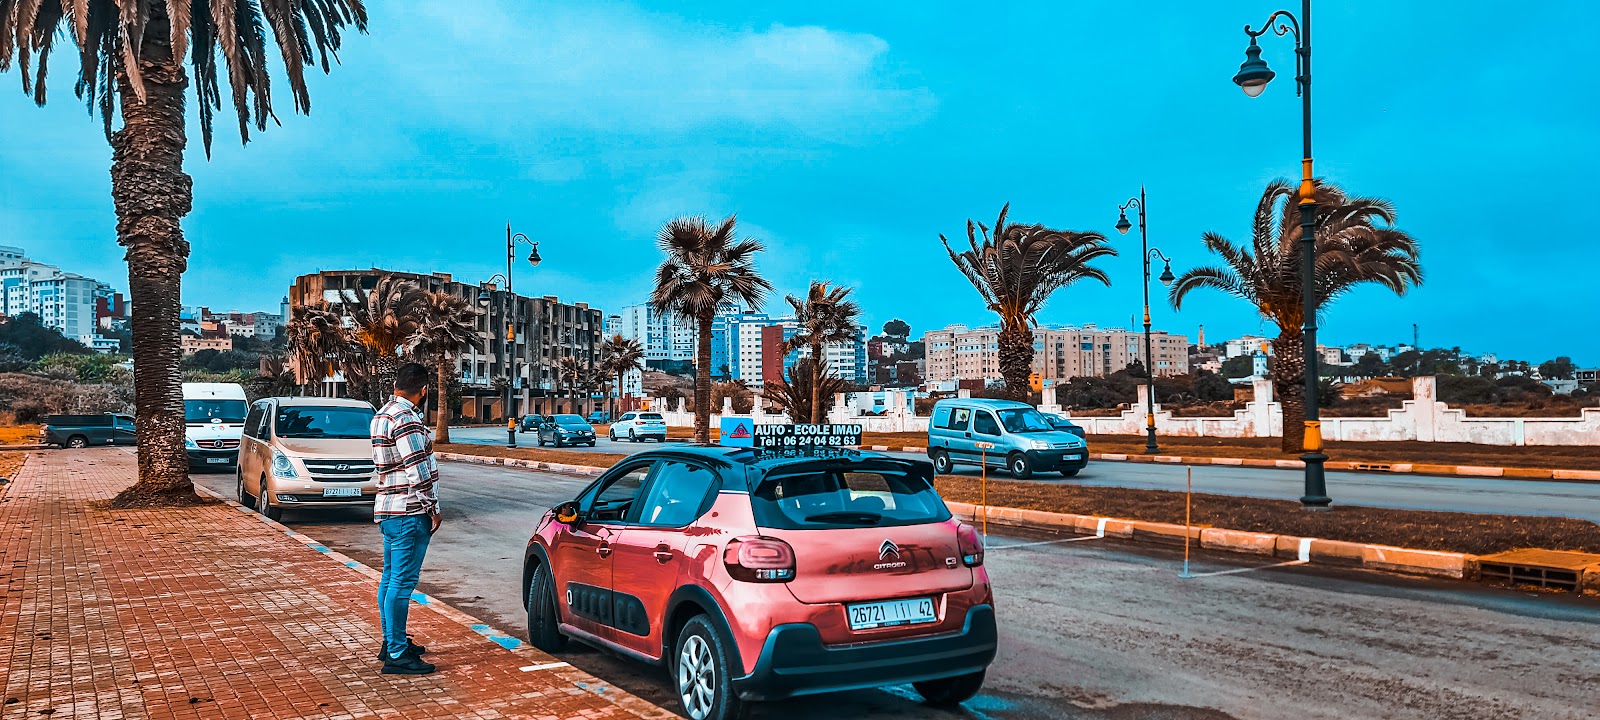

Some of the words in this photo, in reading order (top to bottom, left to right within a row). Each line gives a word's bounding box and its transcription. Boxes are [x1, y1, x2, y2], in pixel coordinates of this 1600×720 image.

[755, 425, 785, 435] AUTO
[794, 425, 830, 435] ECOLE
[832, 425, 862, 435] IMAD
[783, 436, 796, 446] 06
[799, 436, 811, 446] 24
[814, 436, 826, 446] 04
[829, 436, 841, 446] 82
[843, 436, 856, 446] 63
[852, 605, 886, 623] 26721
[919, 601, 932, 616] 42
